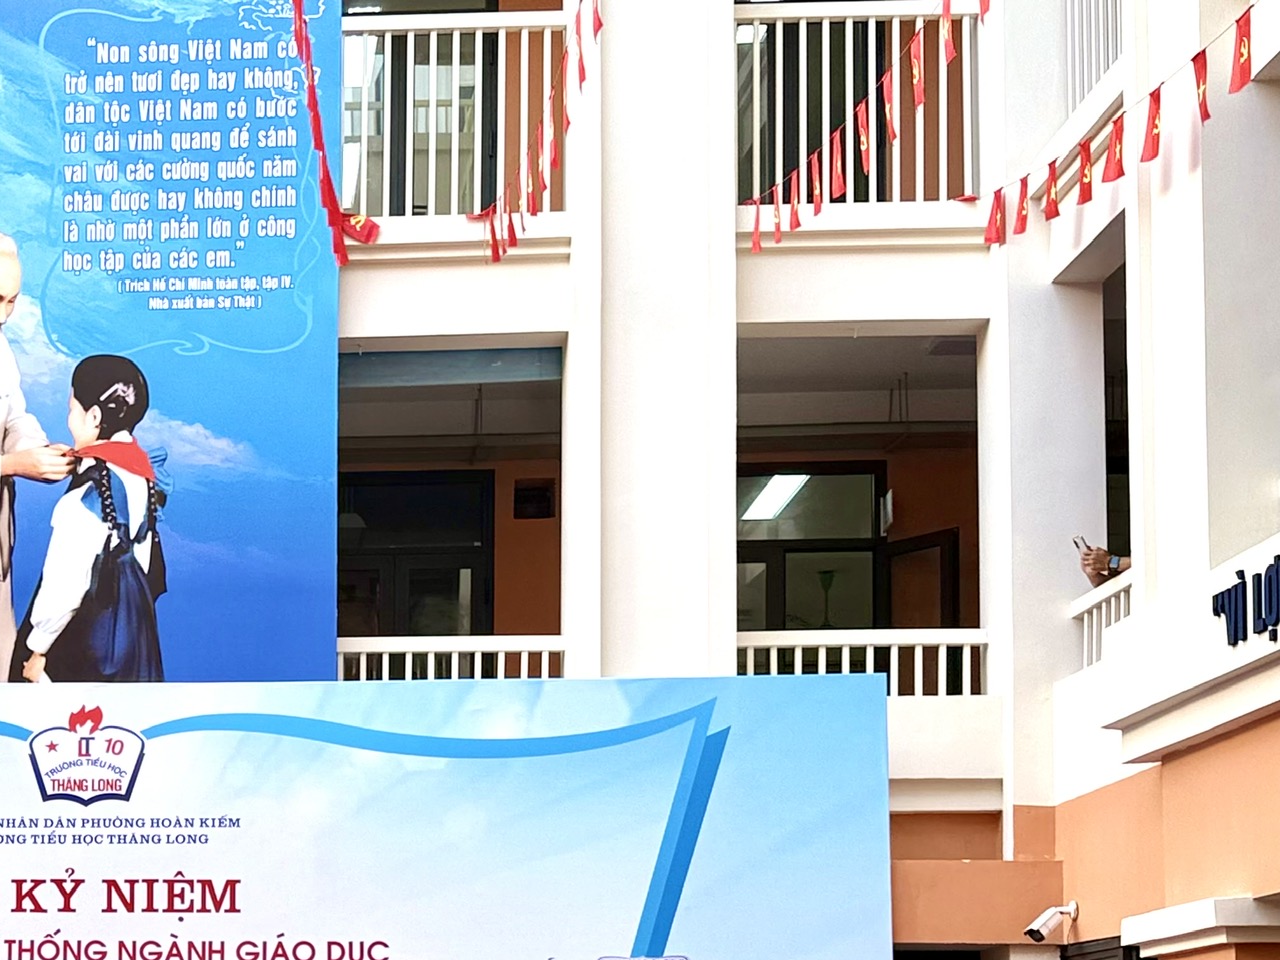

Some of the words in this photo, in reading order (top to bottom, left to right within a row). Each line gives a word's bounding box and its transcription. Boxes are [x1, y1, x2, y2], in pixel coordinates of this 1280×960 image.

[138, 40, 179, 66] sông
[187, 39, 221, 65] Việt
[230, 38, 268, 60] Nam
[277, 38, 298, 59] có
[64, 70, 87, 94] trở
[94, 71, 124, 93] nên
[131, 71, 163, 92] tươi
[171, 70, 200, 95] đẹp
[208, 69, 236, 92] hay
[244, 66, 299, 91] không,
[64, 102, 95, 123] dân
[103, 101, 130, 127] tộc
[139, 99, 172, 126] Việt
[179, 100, 218, 121] Nam
[226, 98, 247, 119] có
[255, 97, 297, 118] bước
[64, 130, 86, 153] tới
[94, 129, 120, 152] đài
[127, 129, 163, 150] vinh
[171, 132, 222, 152] quang
[229, 122, 250, 148] để
[257, 127, 297, 147] sánh
[63, 162, 87, 182] vai
[94, 159, 118, 181] với
[125, 160, 154, 181] các
[162, 158, 210, 181] cường
[217, 153, 256, 181] quốc
[262, 158, 297, 178] năm
[63, 190, 102, 212] châu
[110, 189, 149, 215] được
[157, 189, 186, 212] hay
[194, 187, 243, 211] không
[251, 185, 297, 207] chính
[63, 219, 79, 242] là
[86, 218, 116, 242] nhờ
[123, 219, 153, 245] một
[160, 214, 199, 242] phần
[207, 217, 232, 239] lớn
[239, 213, 250, 238] ở
[257, 217, 296, 239] công
[62, 249, 92, 275] học
[99, 249, 125, 275] tập
[132, 246, 161, 270] của
[169, 248, 198, 269] các
[168, 276, 186, 291] Chí
[215, 276, 239, 290] toàn
[261, 275, 279, 292] tập
[148, 296, 169, 310] Nhà
[171, 294, 194, 309] xuất
[196, 294, 215, 308] bản
[217, 295, 231, 310] Sự
[233, 295, 255, 310] Thật
[104, 738, 124, 755] 10
[50, 777, 88, 792] THĂNG
[91, 778, 122, 792] LONG
[43, 816, 77, 828] DÂN
[150, 815, 195, 828] HOÀN
[199, 814, 241, 828] KIẾM
[71, 834, 104, 846] HỌC
[107, 833, 161, 844] THĂNG
[166, 834, 209, 844] LONG
[11, 867, 85, 913] KỶ
[102, 871, 242, 922] NIỆM
